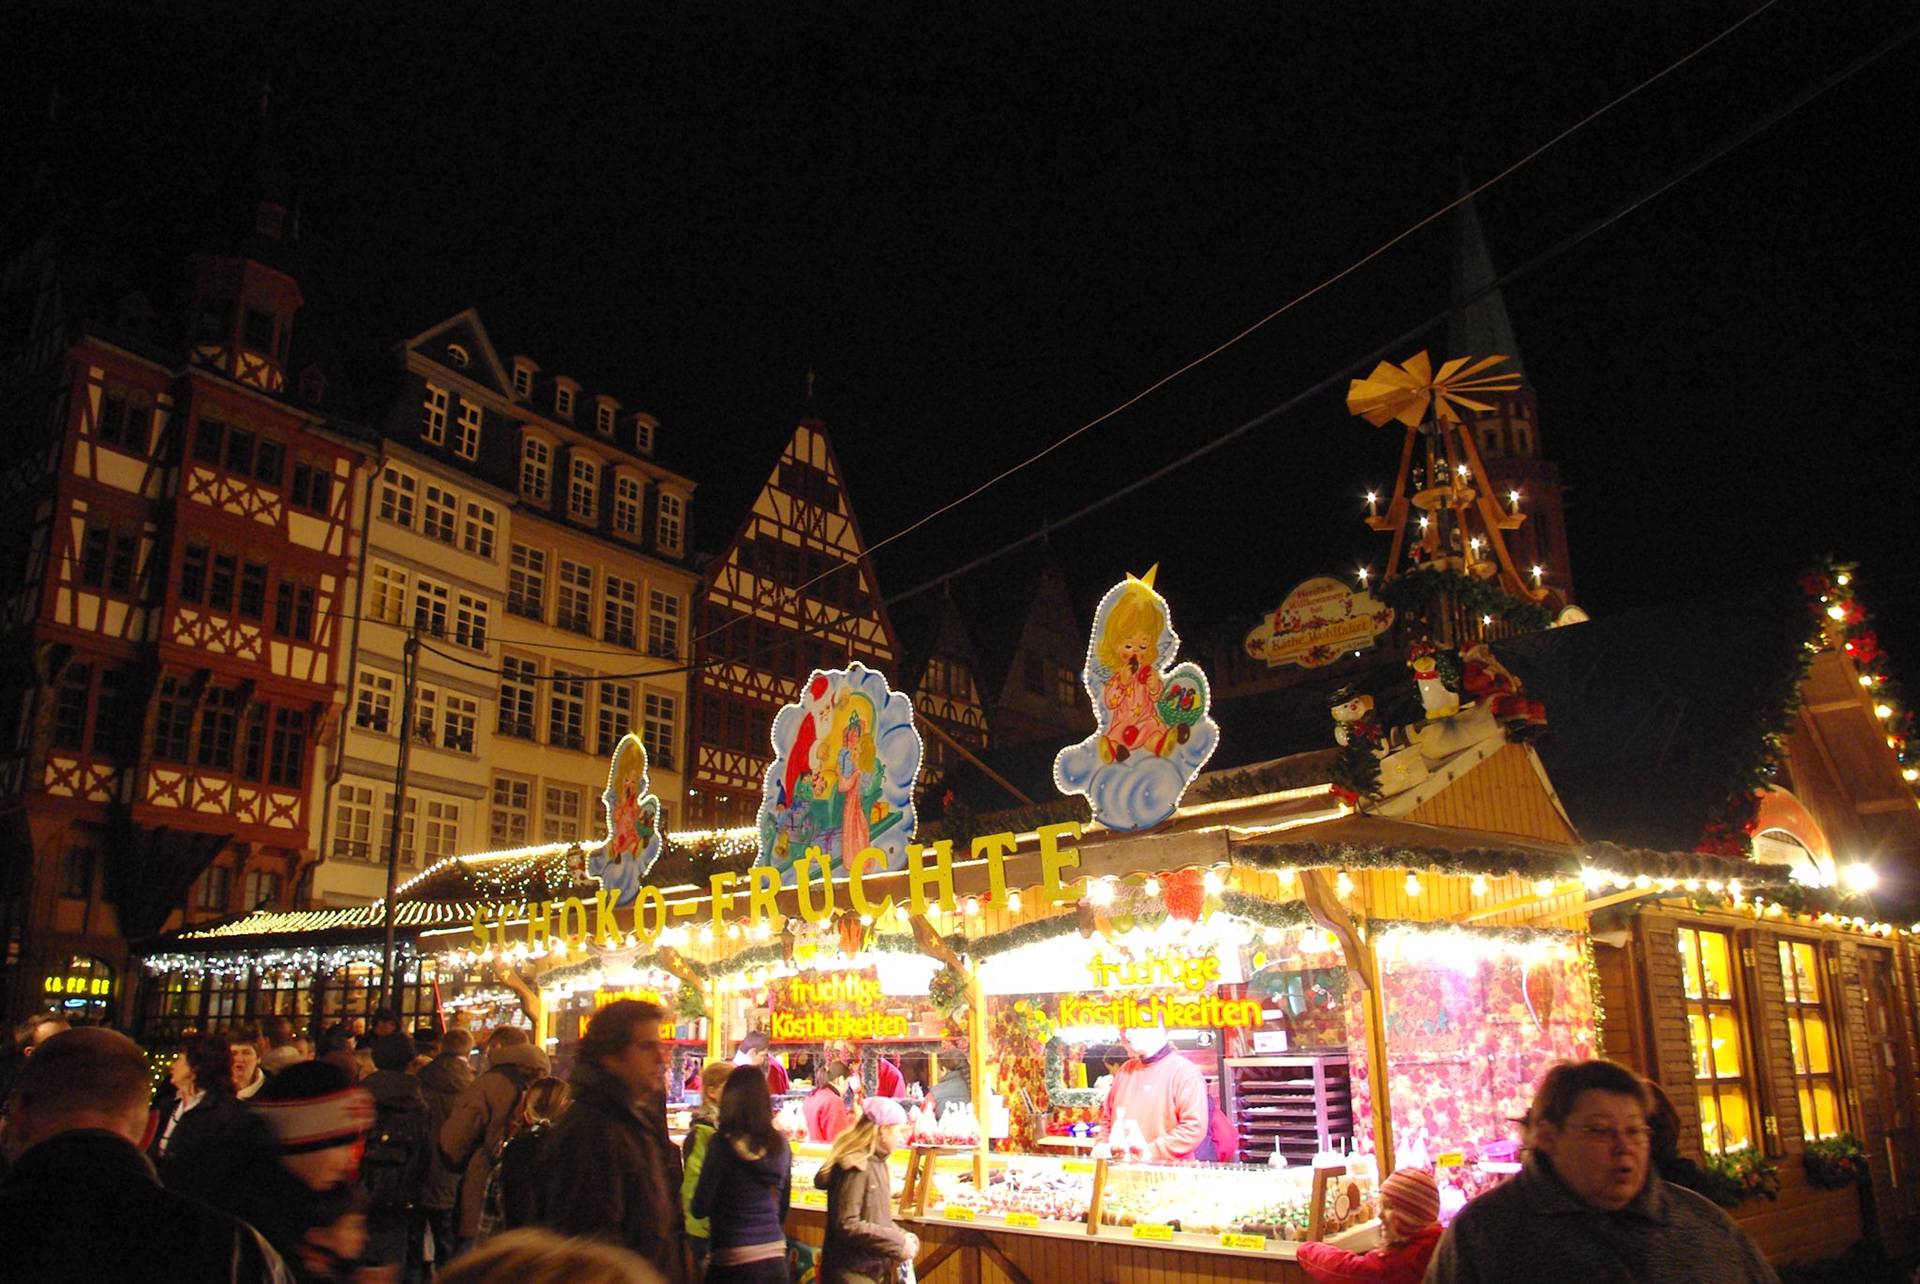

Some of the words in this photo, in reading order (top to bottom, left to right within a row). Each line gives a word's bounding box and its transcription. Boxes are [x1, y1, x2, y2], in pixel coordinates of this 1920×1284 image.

[1288, 592, 1345, 610] Willkommen
[1297, 584, 1334, 599] Herzlich
[1307, 621, 1368, 643] Wohlfahrt
[471, 821, 1088, 955] SCHOKO-FRÜCHTE
[1086, 947, 1223, 991] fruchtige
[789, 973, 884, 1007] fruchtige
[771, 1010, 909, 1038] Köstlichkeiten
[1059, 993, 1266, 1029] Köstlichkeiten
